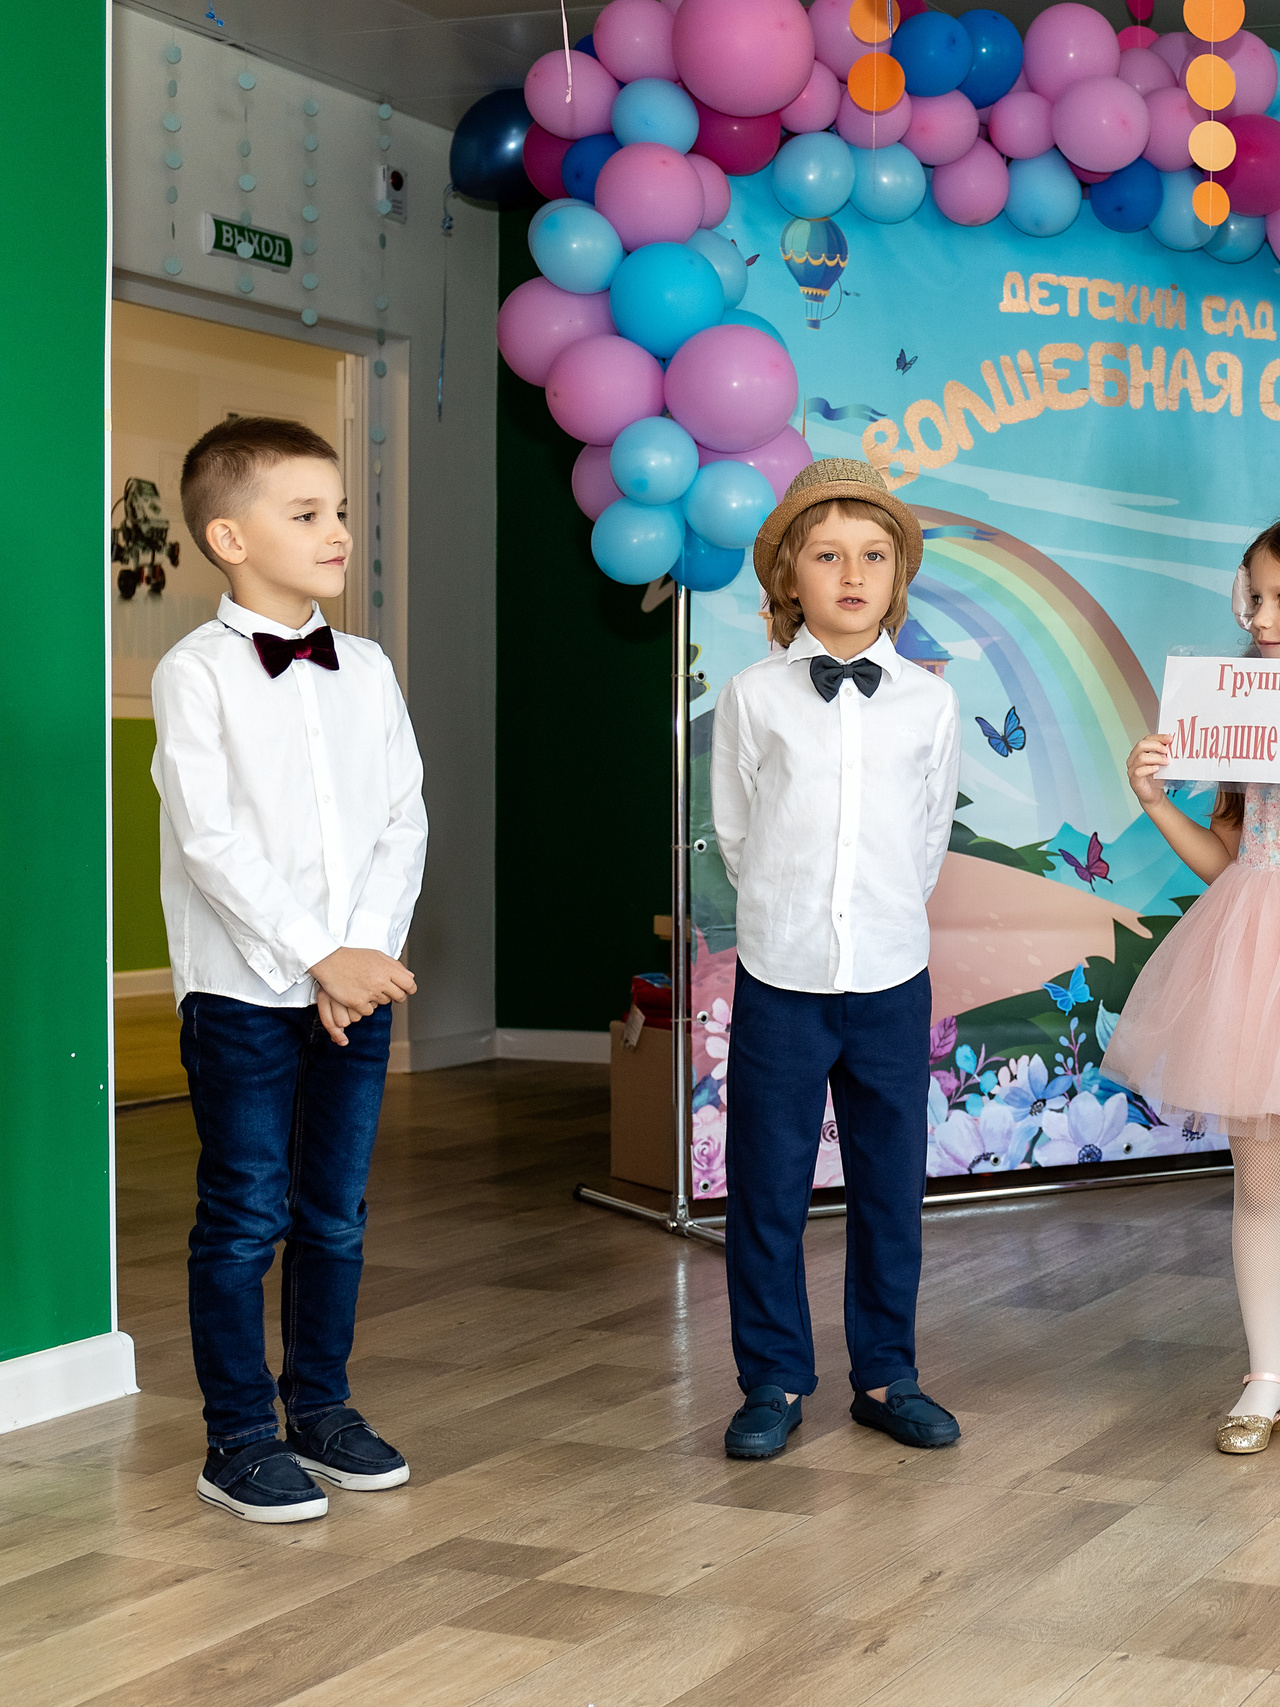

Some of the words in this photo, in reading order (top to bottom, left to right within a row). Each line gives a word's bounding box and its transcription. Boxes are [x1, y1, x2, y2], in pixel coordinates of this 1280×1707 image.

[222, 224, 286, 263] ВЫХОД
[999, 271, 1187, 331] ДЕТСКИЙ
[1201, 295, 1277, 342] САД
[861, 341, 1244, 492] ВОЛШЕБНАЯ
